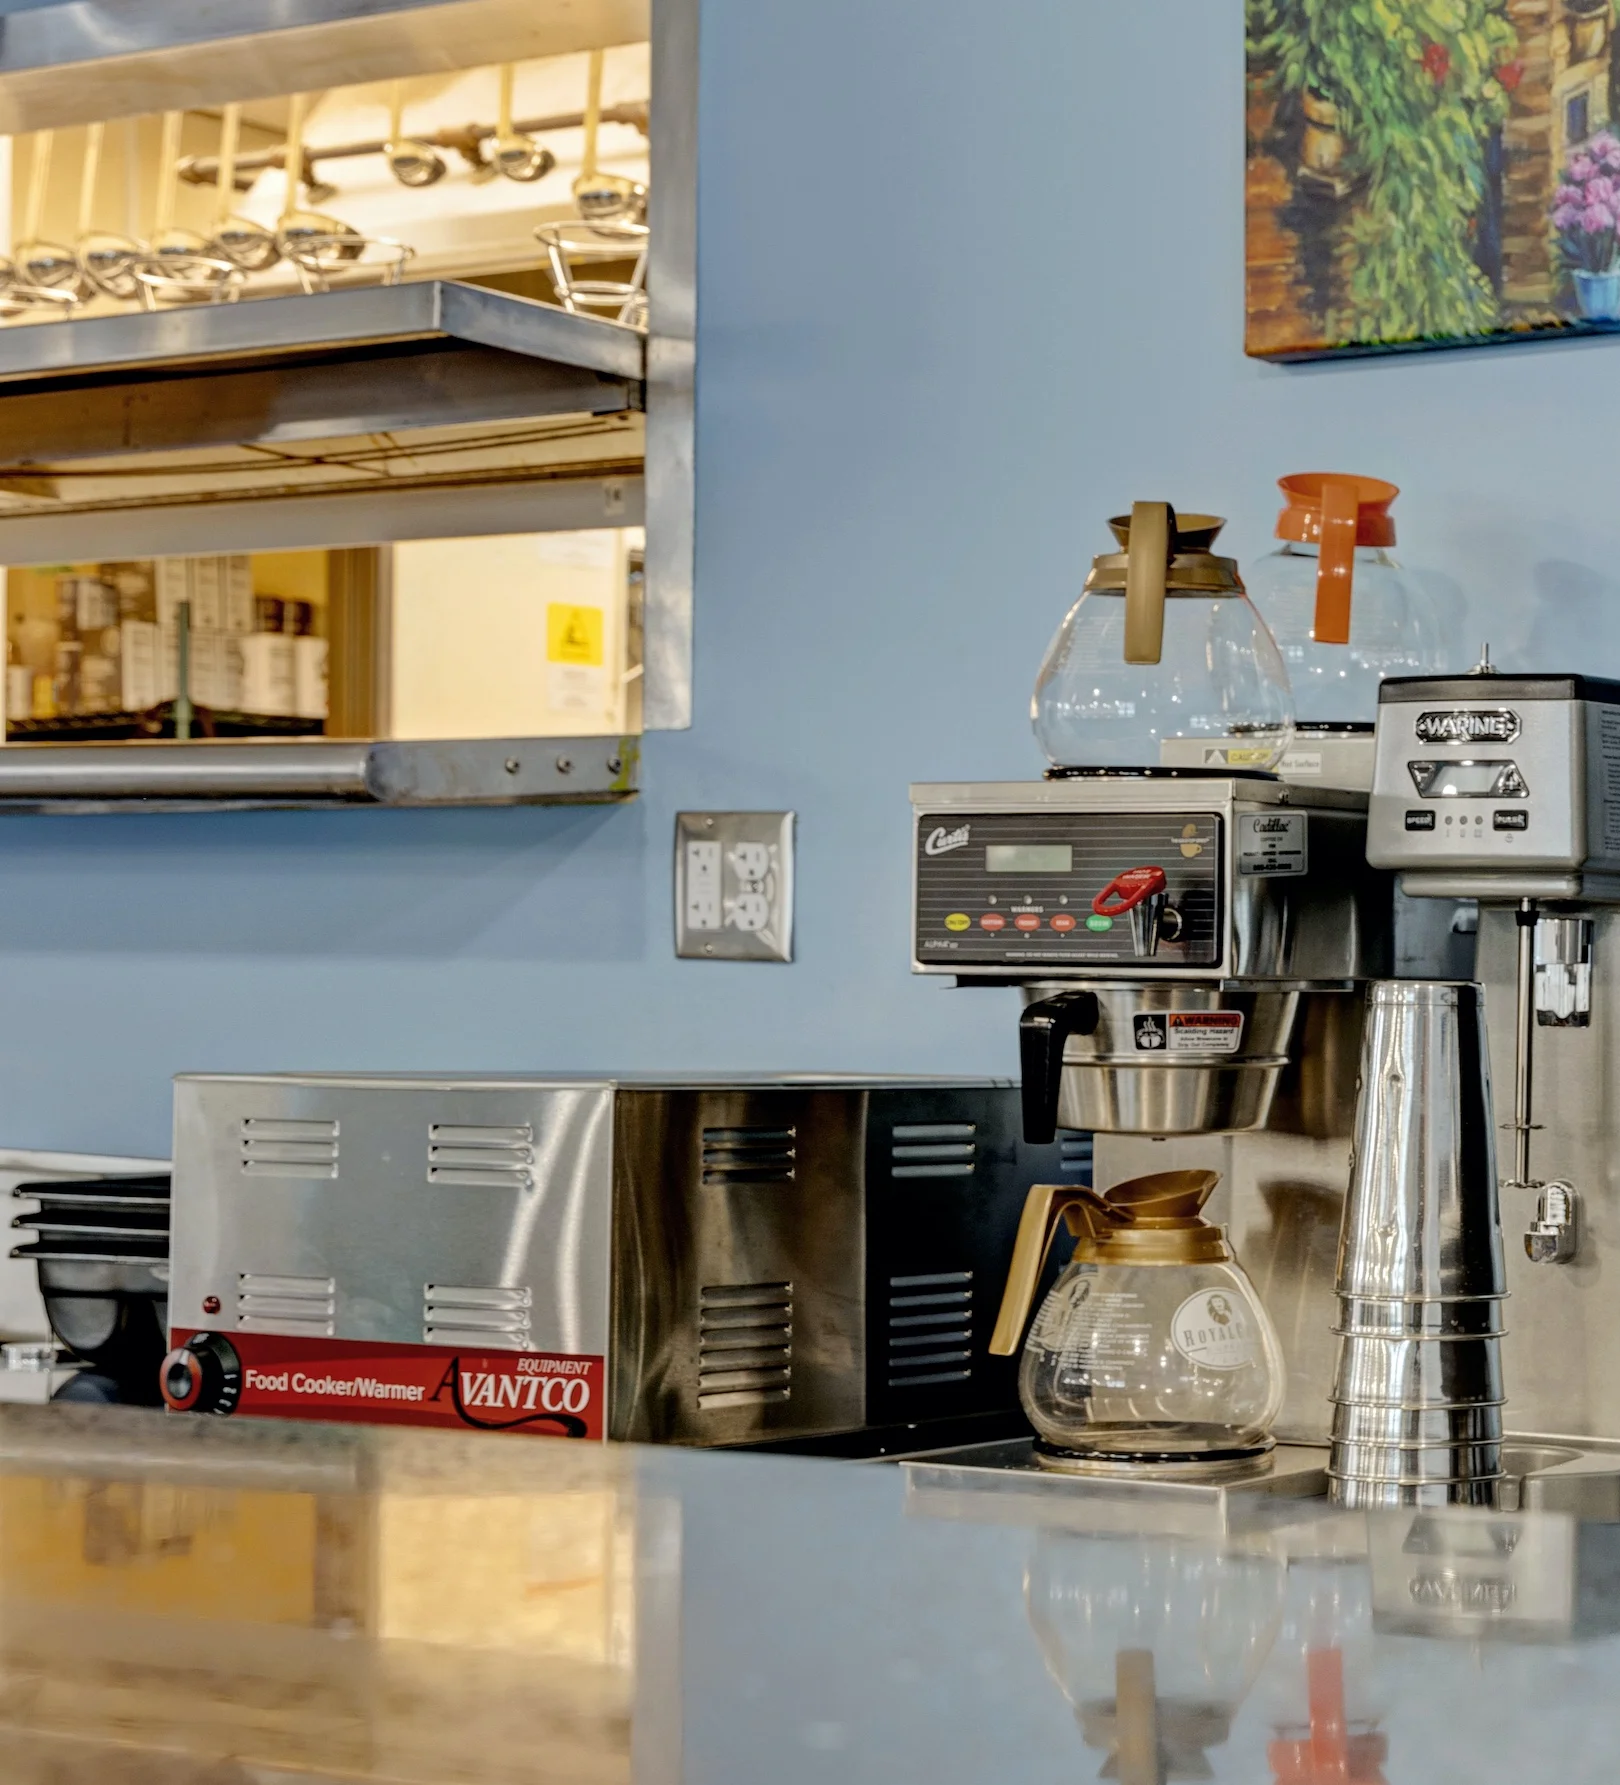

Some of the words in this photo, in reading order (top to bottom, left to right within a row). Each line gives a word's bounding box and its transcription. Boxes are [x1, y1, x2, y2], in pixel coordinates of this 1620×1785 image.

[1425, 715, 1506, 741] WARING
[925, 824, 971, 855] Curtis
[1184, 1016, 1238, 1025] WARNING
[516, 1358, 592, 1375] EQUIPMENT
[245, 1369, 289, 1391] Food
[291, 1372, 425, 1402] Cooker/Warmer
[428, 1356, 592, 1437] AVANTCO
